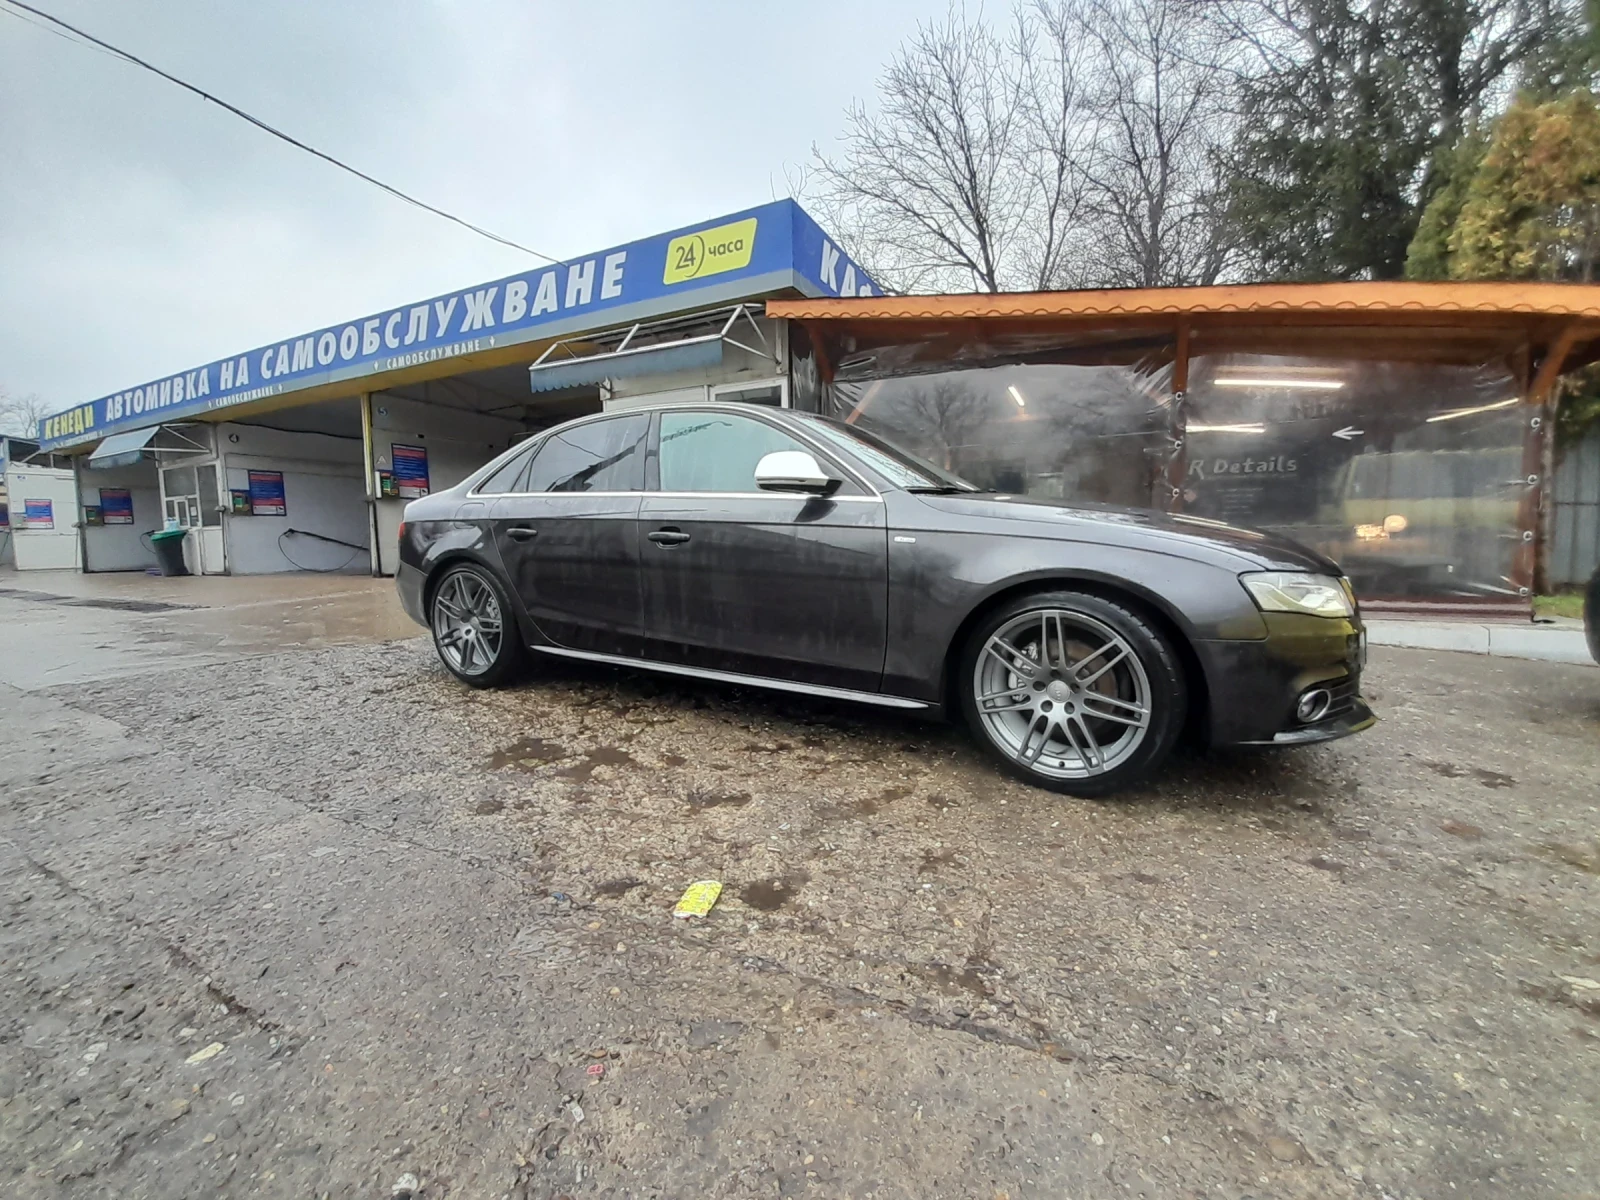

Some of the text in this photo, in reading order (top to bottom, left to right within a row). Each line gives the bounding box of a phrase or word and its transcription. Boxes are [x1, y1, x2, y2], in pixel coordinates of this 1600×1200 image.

[675, 238, 744, 270] 24 часа
[45, 405, 94, 440] КЕНЕДИ
[106, 367, 211, 422] АВТОМИВКА
[220, 356, 249, 391] НА
[261, 251, 627, 379] САМООБСЛУЖВАНЕ
[387, 339, 480, 369] САМООБСЛУЖВАНЕ
[1213, 456, 1297, 474] Details
